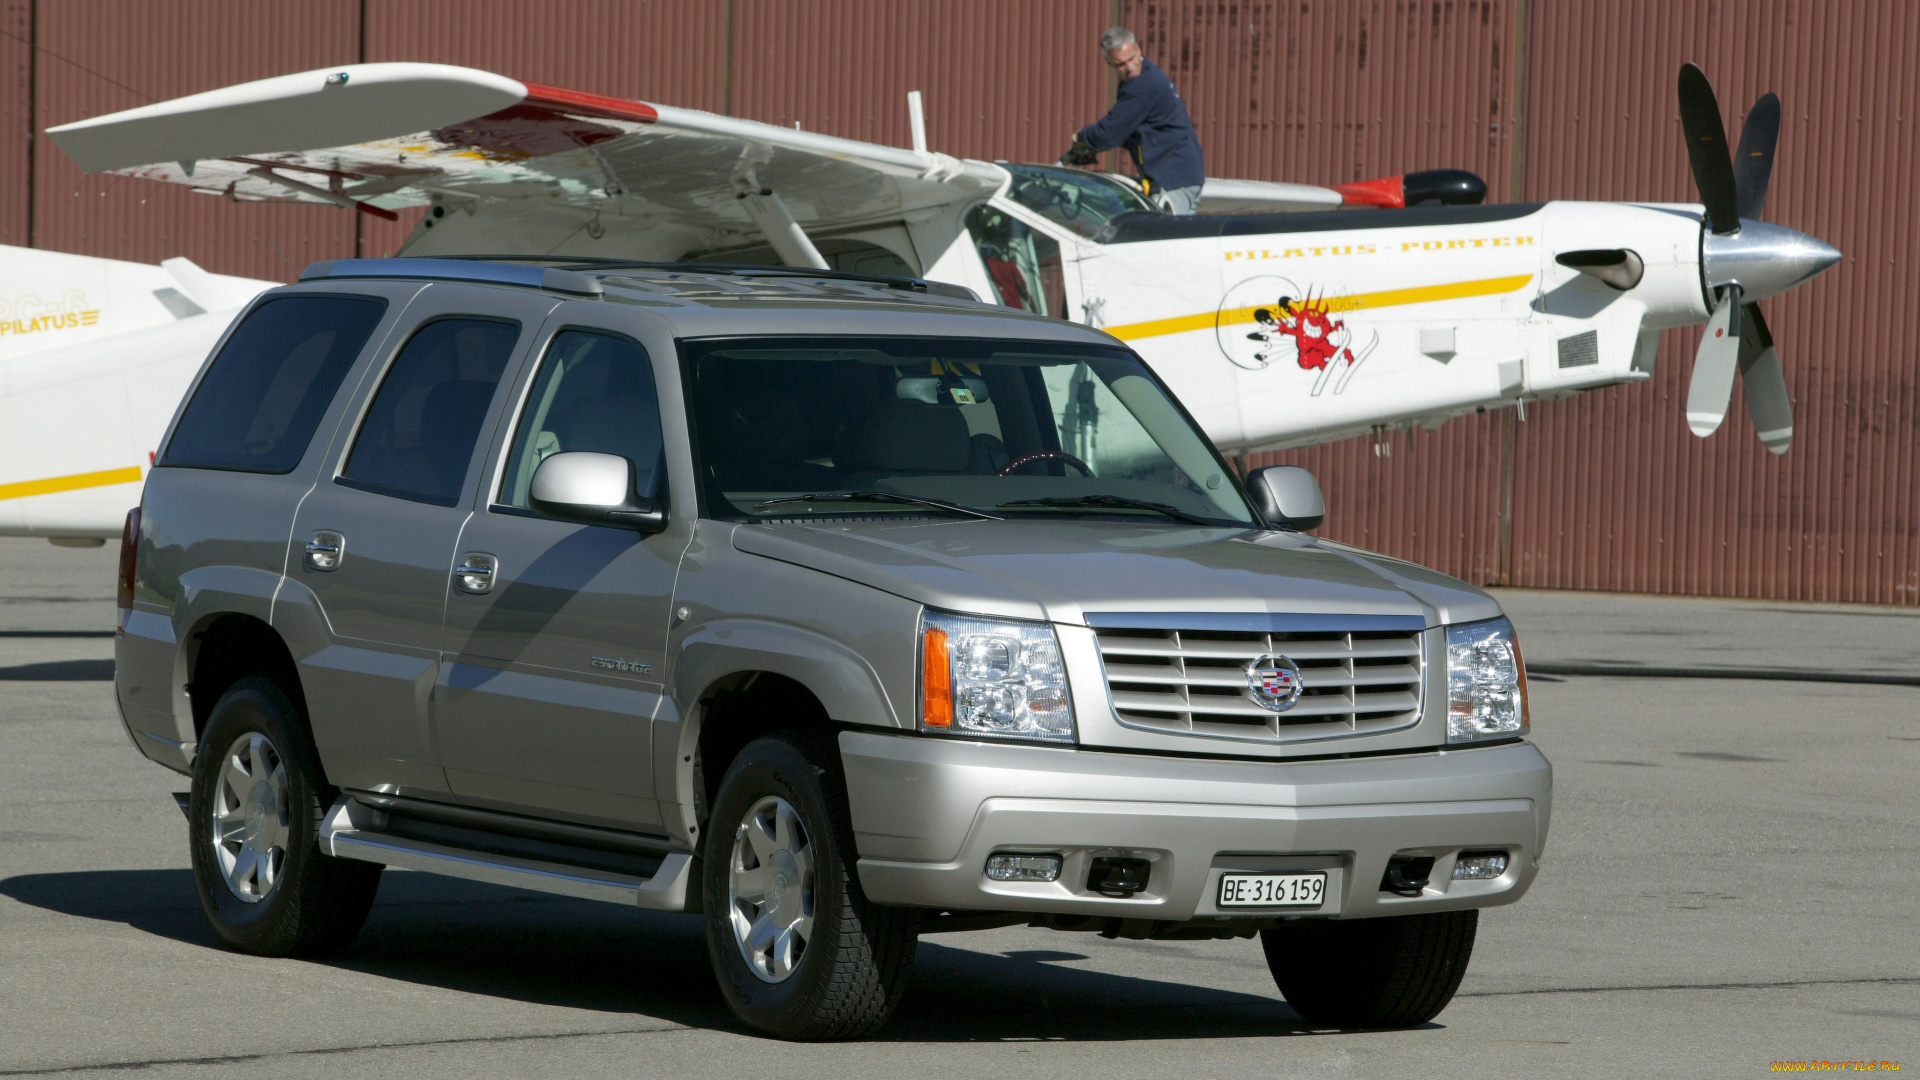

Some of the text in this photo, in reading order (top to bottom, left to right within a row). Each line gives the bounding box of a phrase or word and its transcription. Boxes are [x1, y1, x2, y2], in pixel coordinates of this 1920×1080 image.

[1223, 244, 1377, 261] PILATUS
[1400, 236, 1535, 252] PORTER
[0, 312, 79, 336] PILATUS
[1290, 879, 1323, 901] 159
